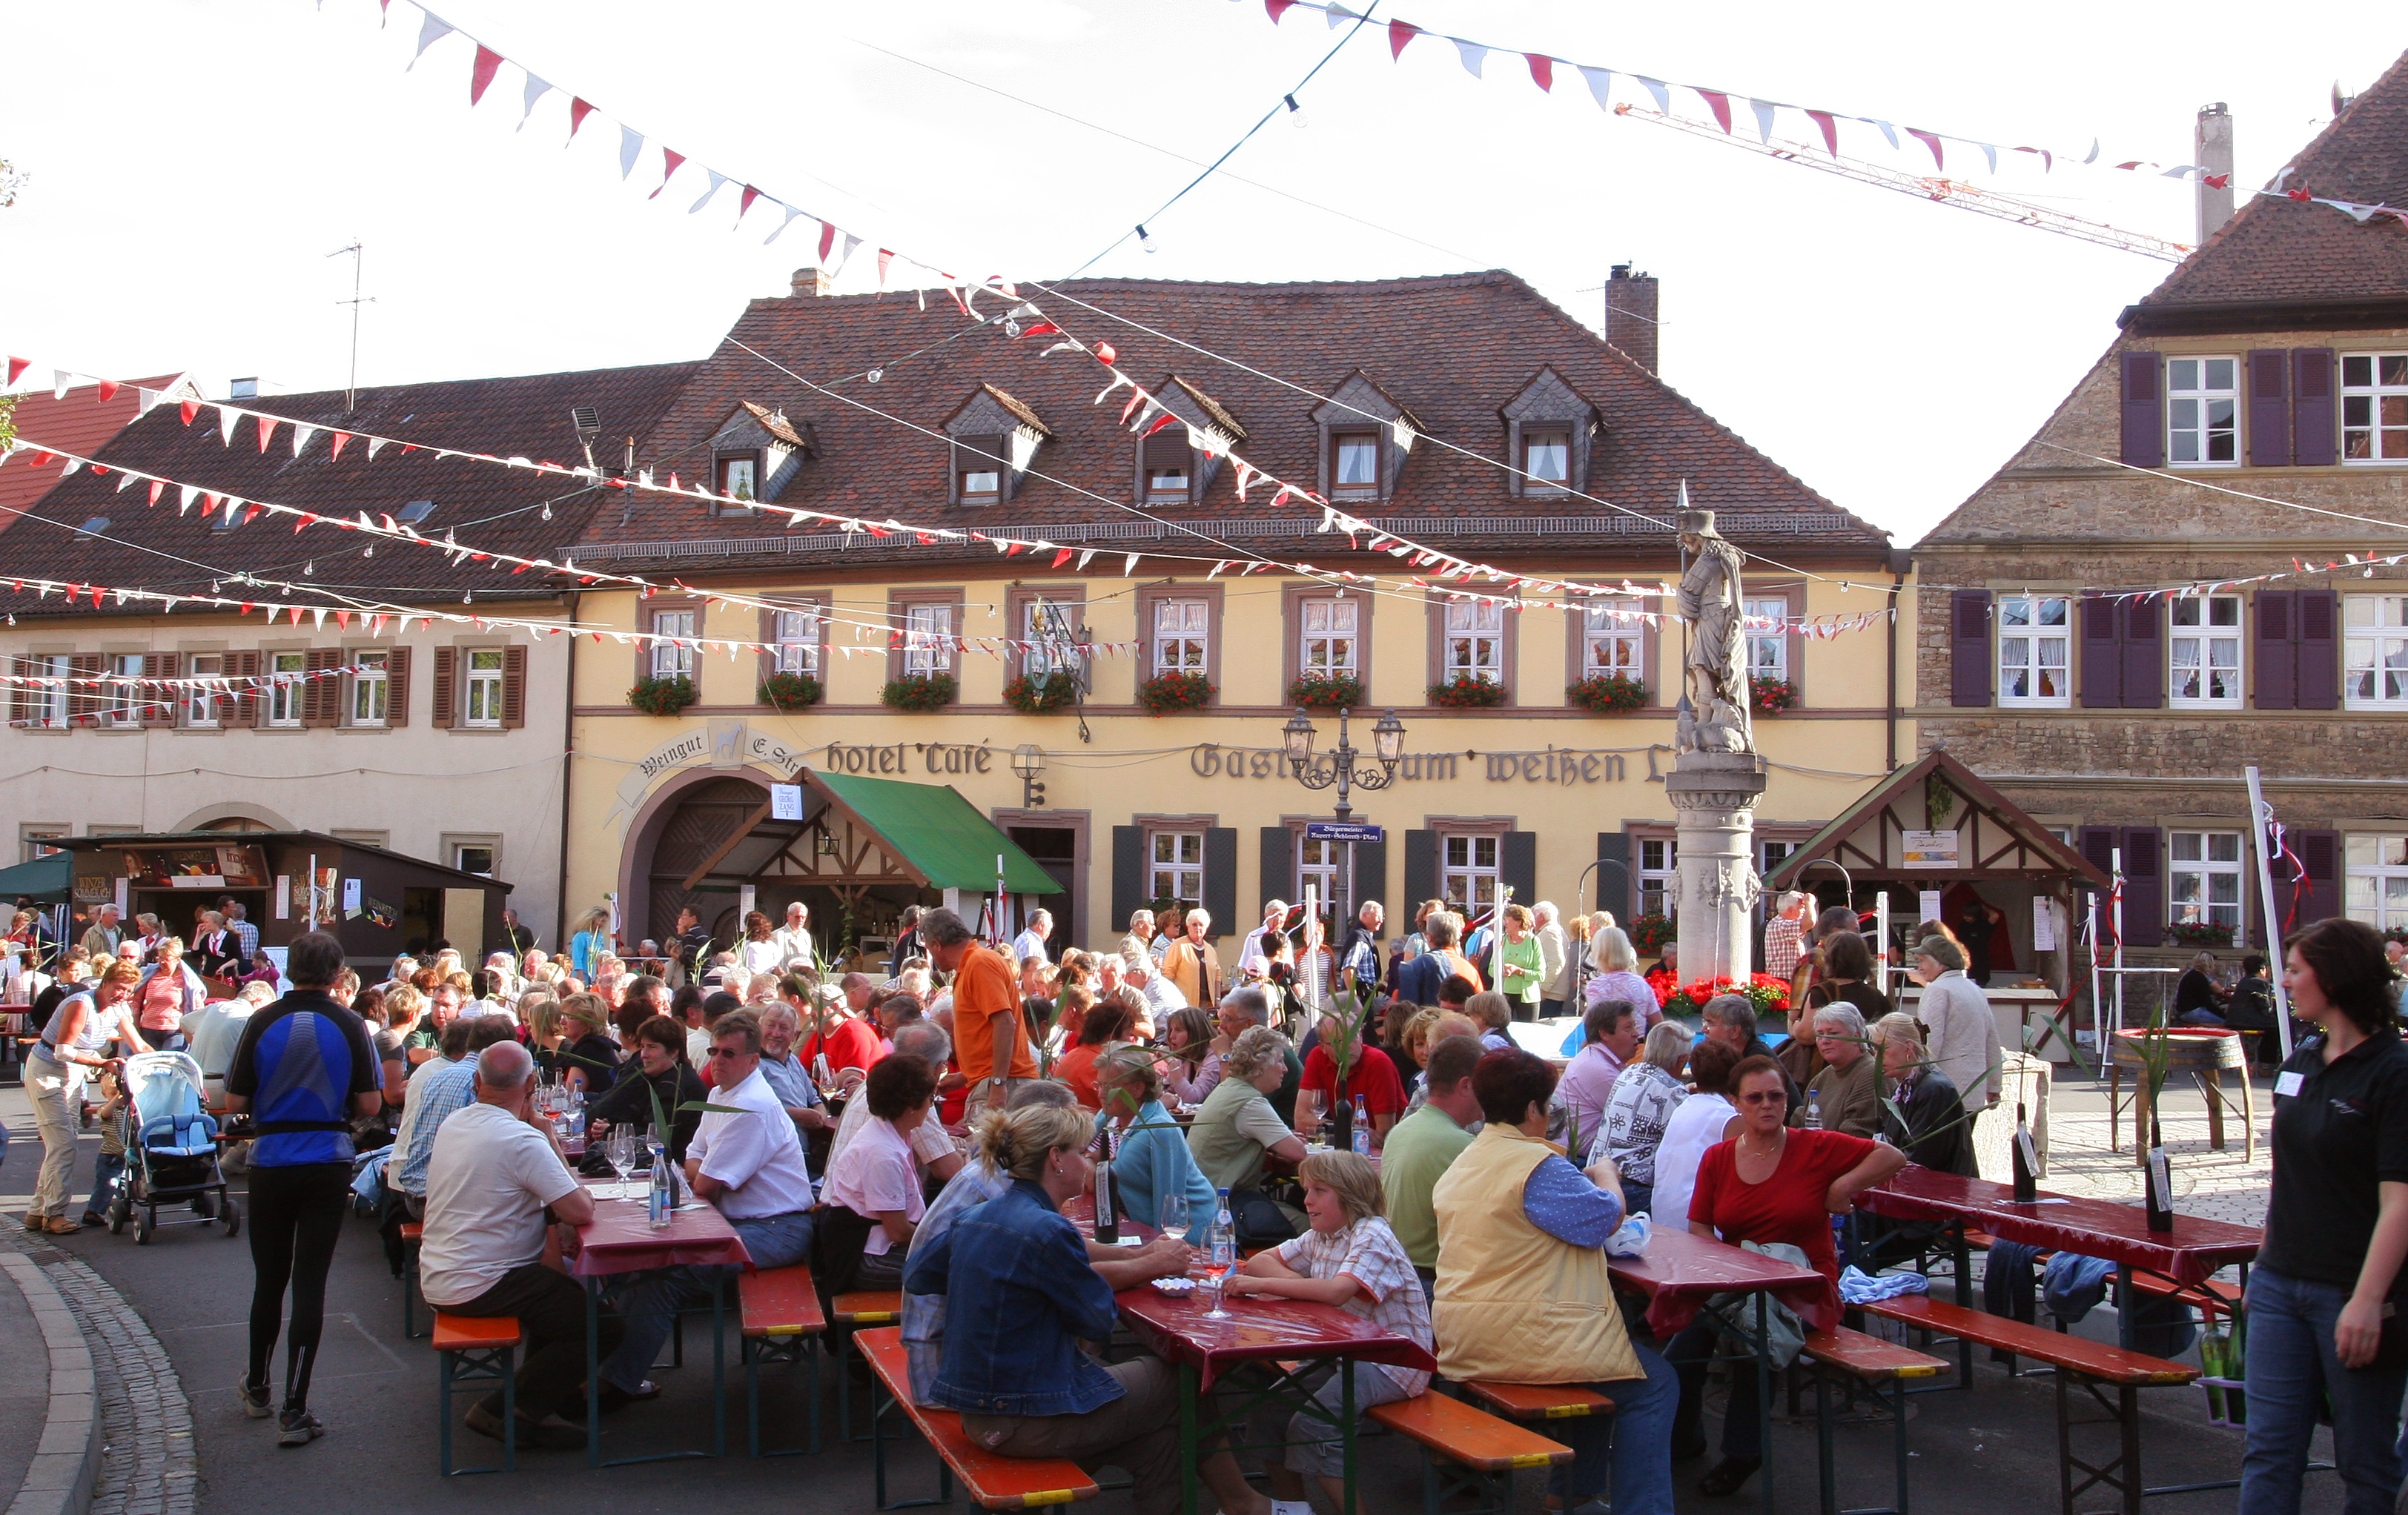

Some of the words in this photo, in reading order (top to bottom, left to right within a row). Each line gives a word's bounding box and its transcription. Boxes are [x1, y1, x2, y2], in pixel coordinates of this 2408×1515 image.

[640, 735, 702, 779] Weingut
[752, 737, 767, 756] E.
[927, 737, 992, 773] Café
[1485, 743, 1625, 786] weißen
